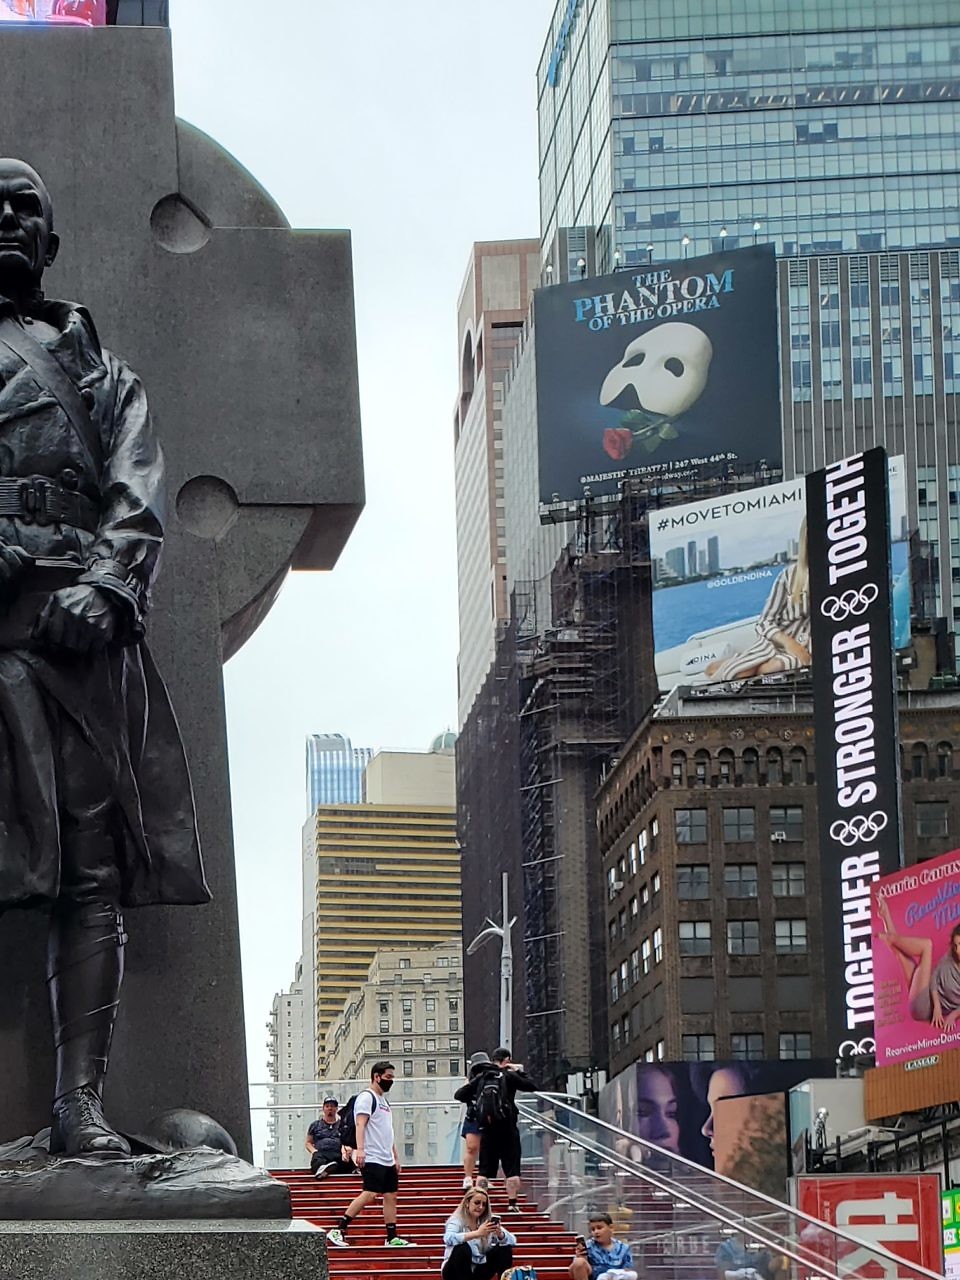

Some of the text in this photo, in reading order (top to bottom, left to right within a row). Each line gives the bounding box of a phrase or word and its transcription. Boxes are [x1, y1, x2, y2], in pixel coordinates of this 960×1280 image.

[573, 269, 735, 322] PHANTOM
[632, 269, 672, 288] THE
[589, 295, 721, 331] OF THE OPERA
[674, 461, 689, 470] 247
[656, 488, 802, 532] #MOVETOMIAMI
[707, 569, 773, 589] @GOLDENDINA
[831, 623, 878, 808] STRONGER
[841, 851, 881, 1030] TOGETHER
